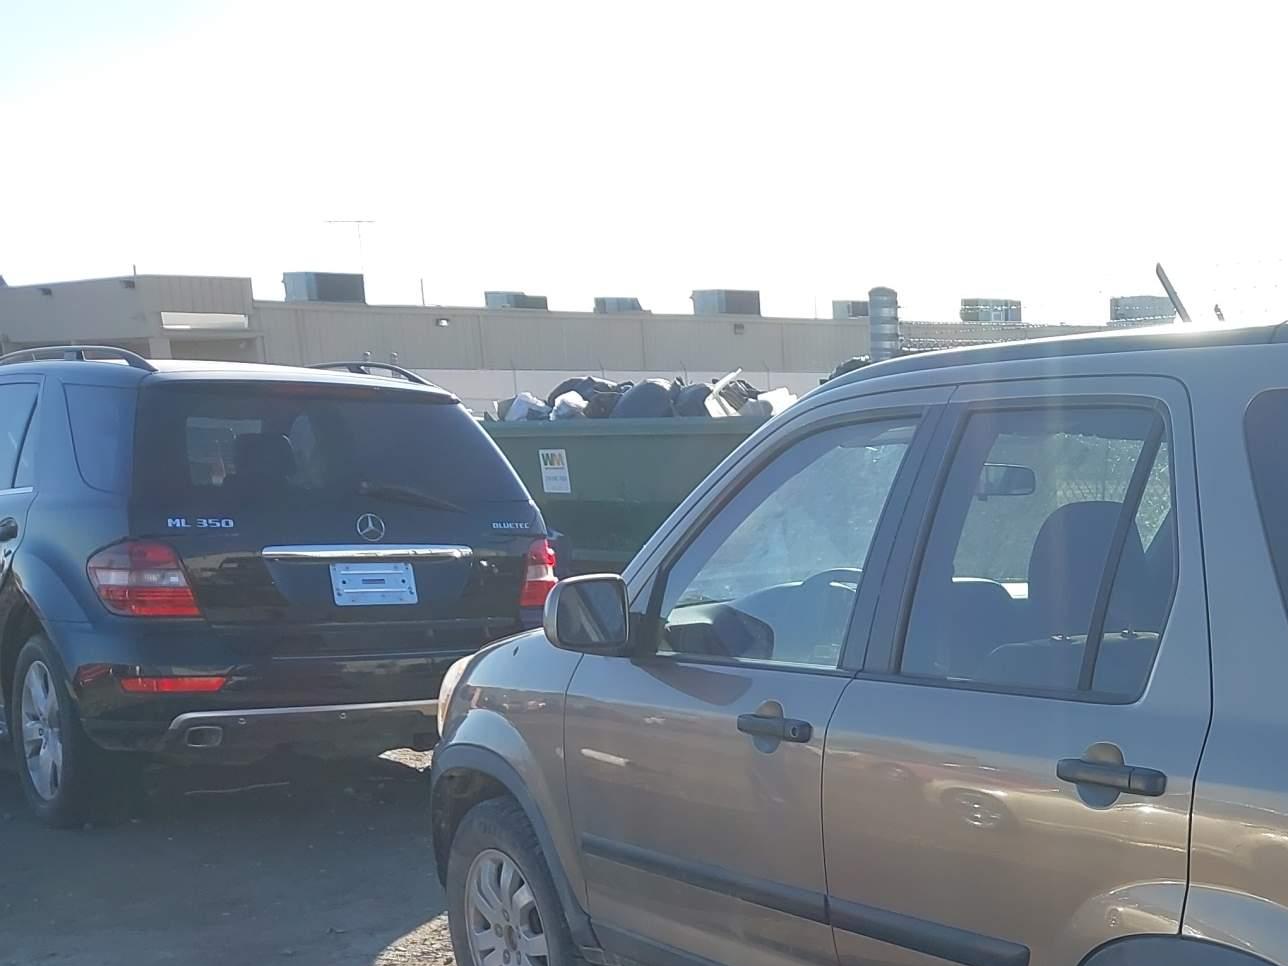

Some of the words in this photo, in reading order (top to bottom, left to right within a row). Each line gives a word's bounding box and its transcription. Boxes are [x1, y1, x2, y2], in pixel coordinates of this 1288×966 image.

[541, 453, 564, 466] WM
[167, 518, 192, 528] ML
[196, 518, 234, 528] 350
